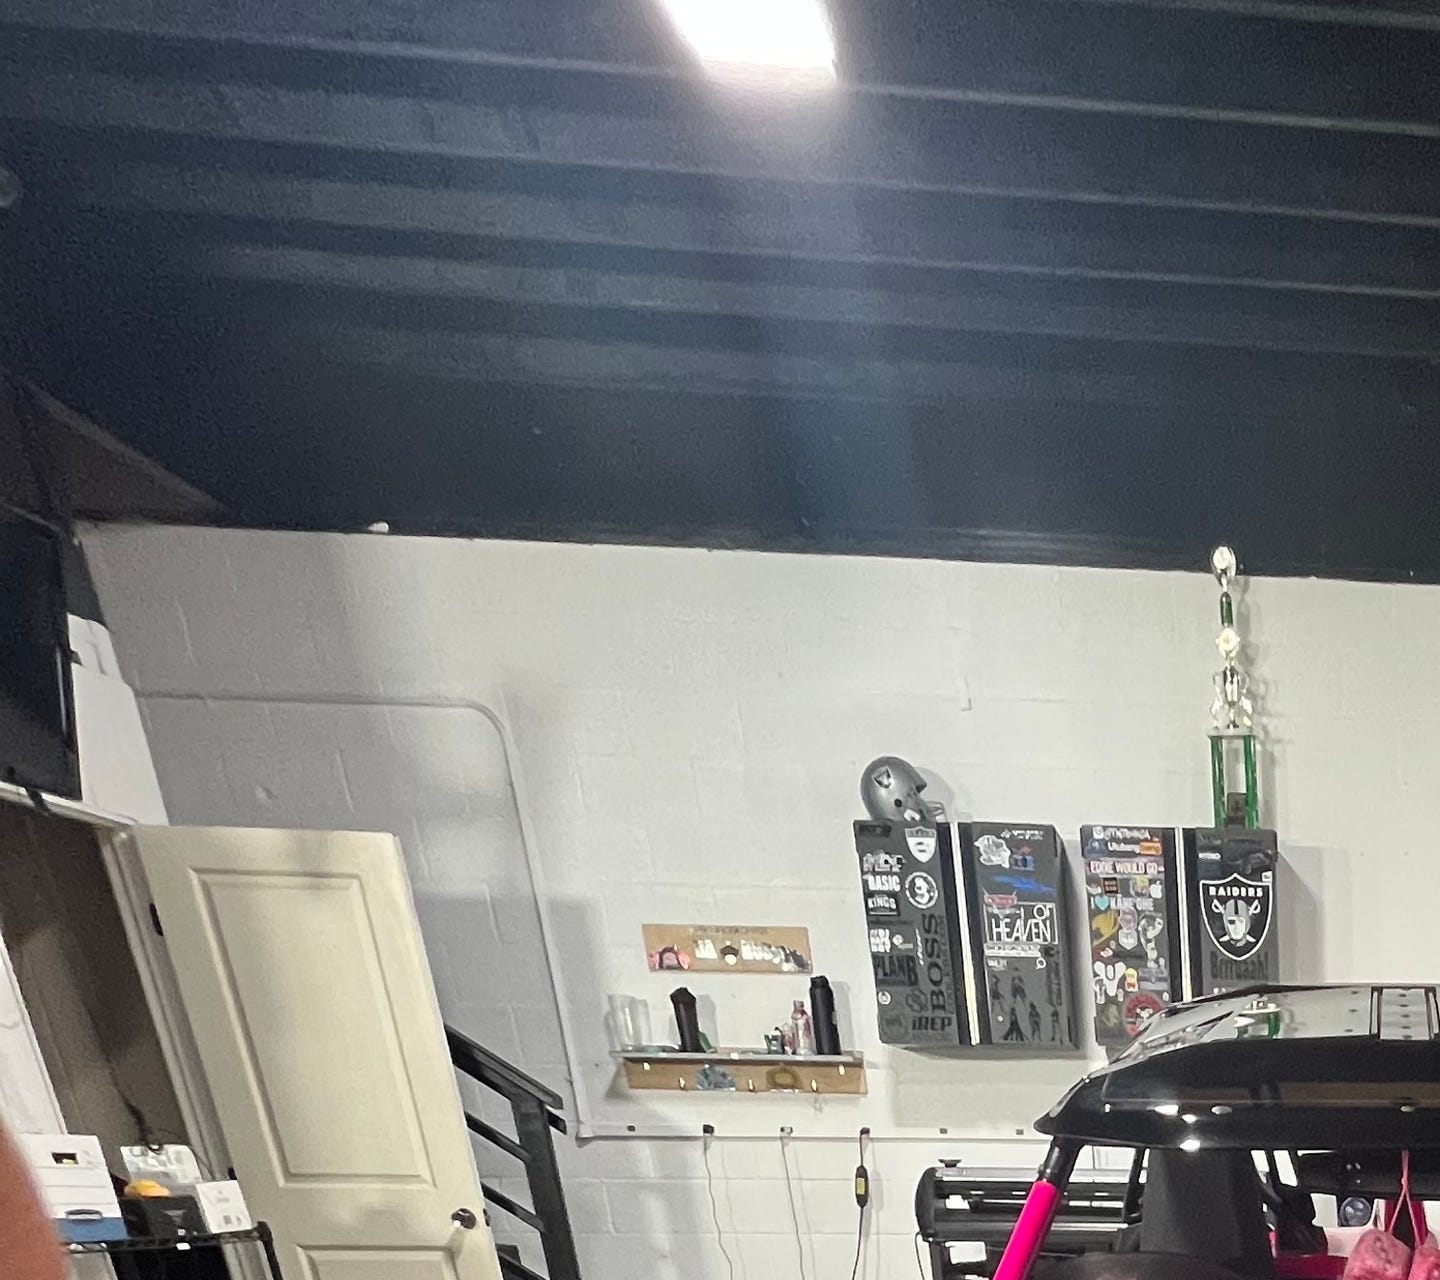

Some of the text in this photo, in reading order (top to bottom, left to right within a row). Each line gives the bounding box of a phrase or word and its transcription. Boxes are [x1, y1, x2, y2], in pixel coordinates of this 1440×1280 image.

[1115, 862, 1145, 874] WOULD
[1209, 886, 1263, 897] RAIDERS
[867, 896, 897, 909] KINGS
[991, 917, 1051, 943] HEAVEN
[921, 913, 946, 1013] BOSS
